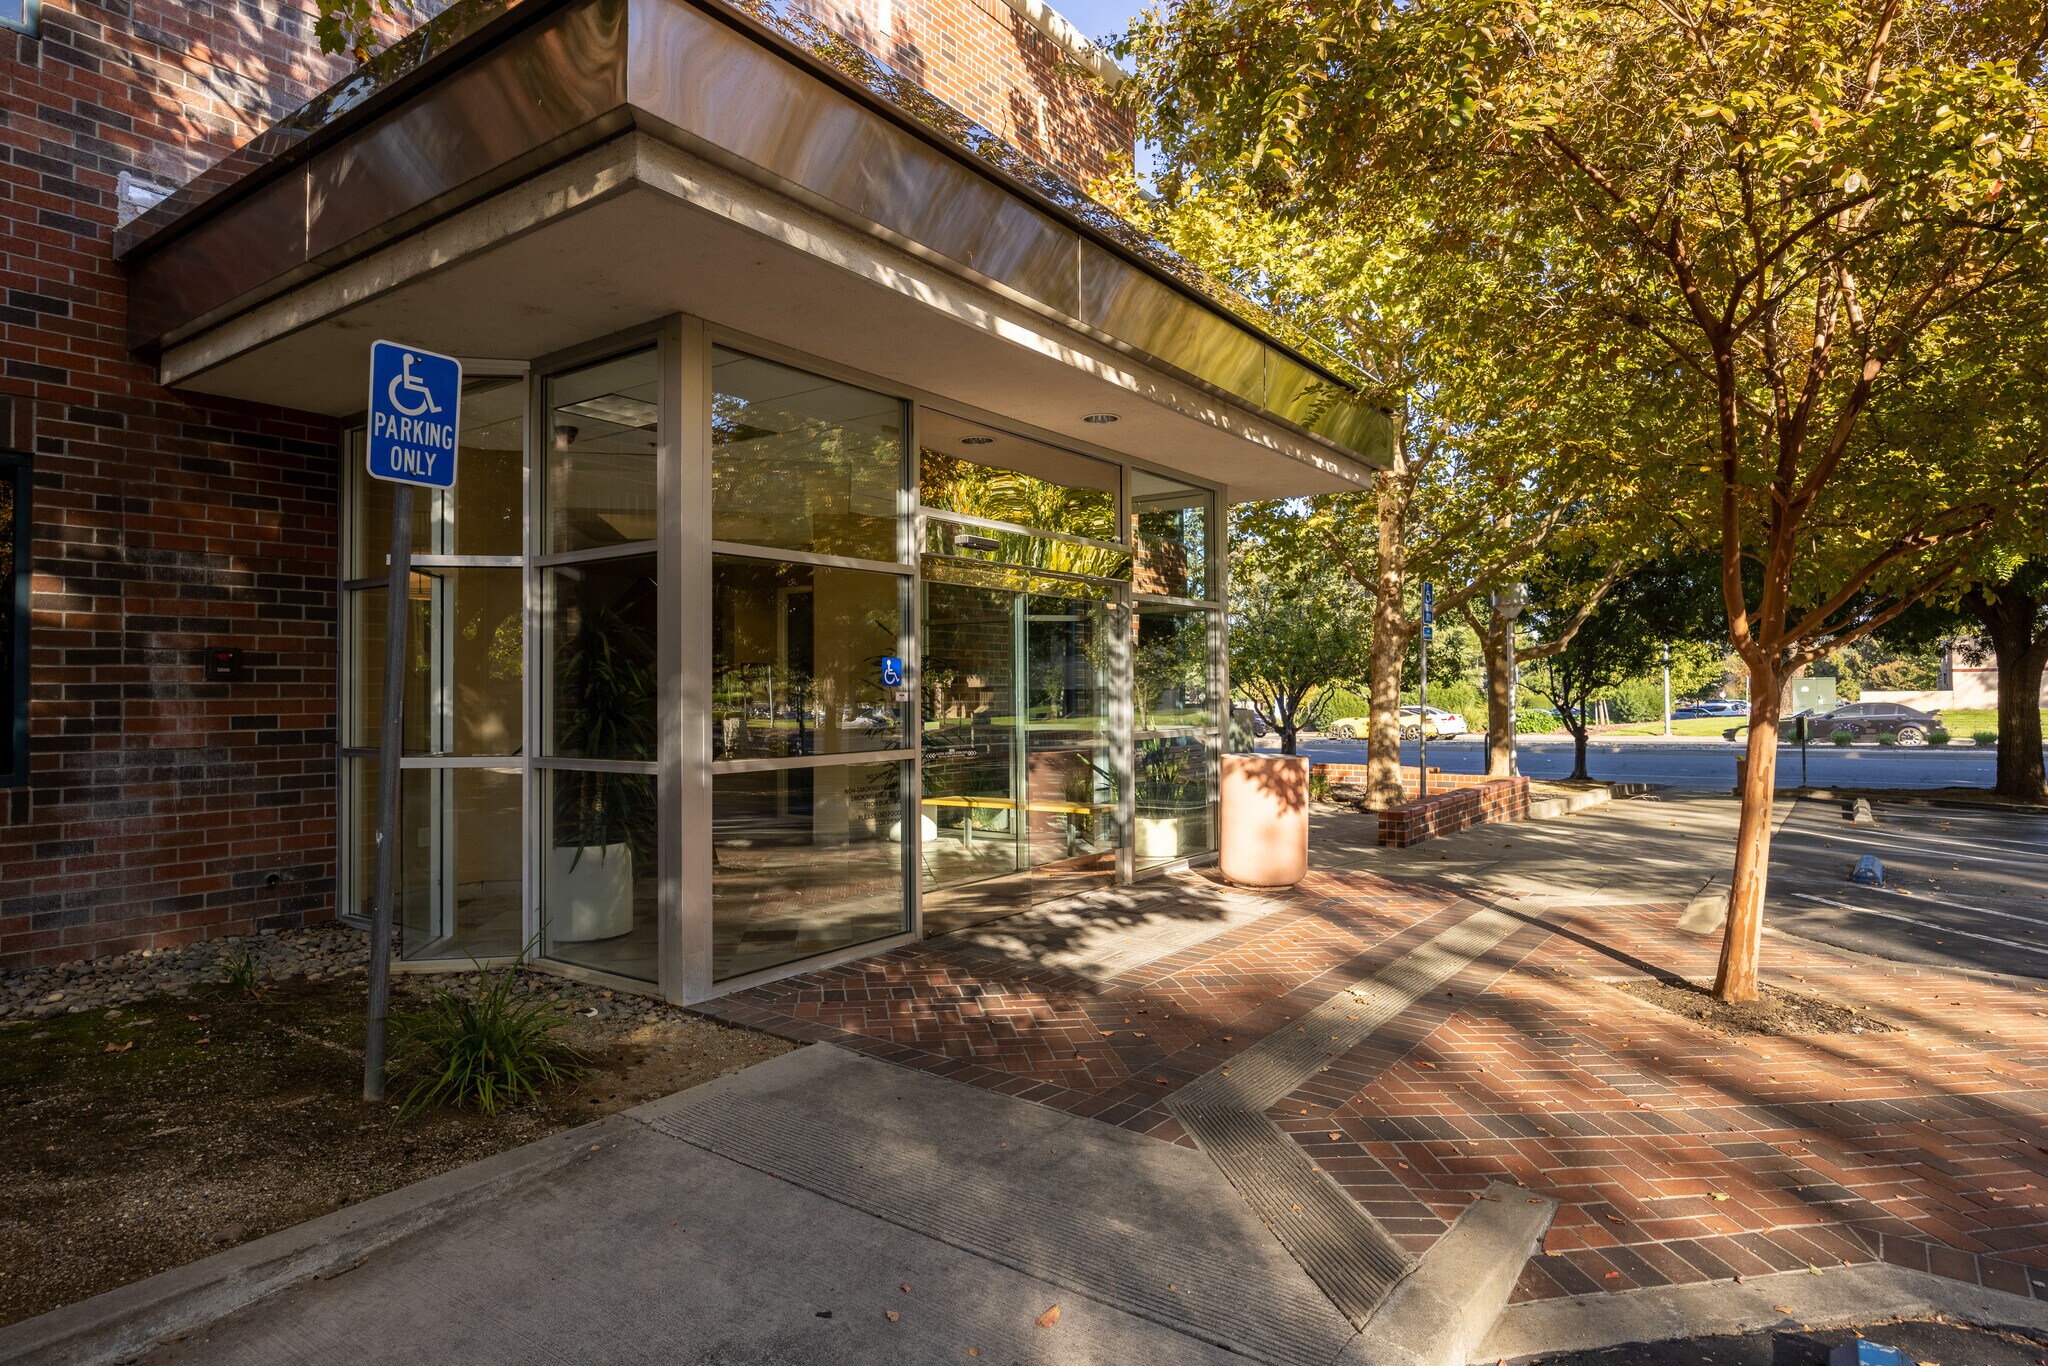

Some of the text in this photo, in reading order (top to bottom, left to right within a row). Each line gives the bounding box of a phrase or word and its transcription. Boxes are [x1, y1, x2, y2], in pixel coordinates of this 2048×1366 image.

[374, 411, 453, 450] PARKING
[390, 445, 437, 476] ONLY
[844, 785, 880, 794] NON-SMOKING
[850, 793, 874, 801] SMOKING
